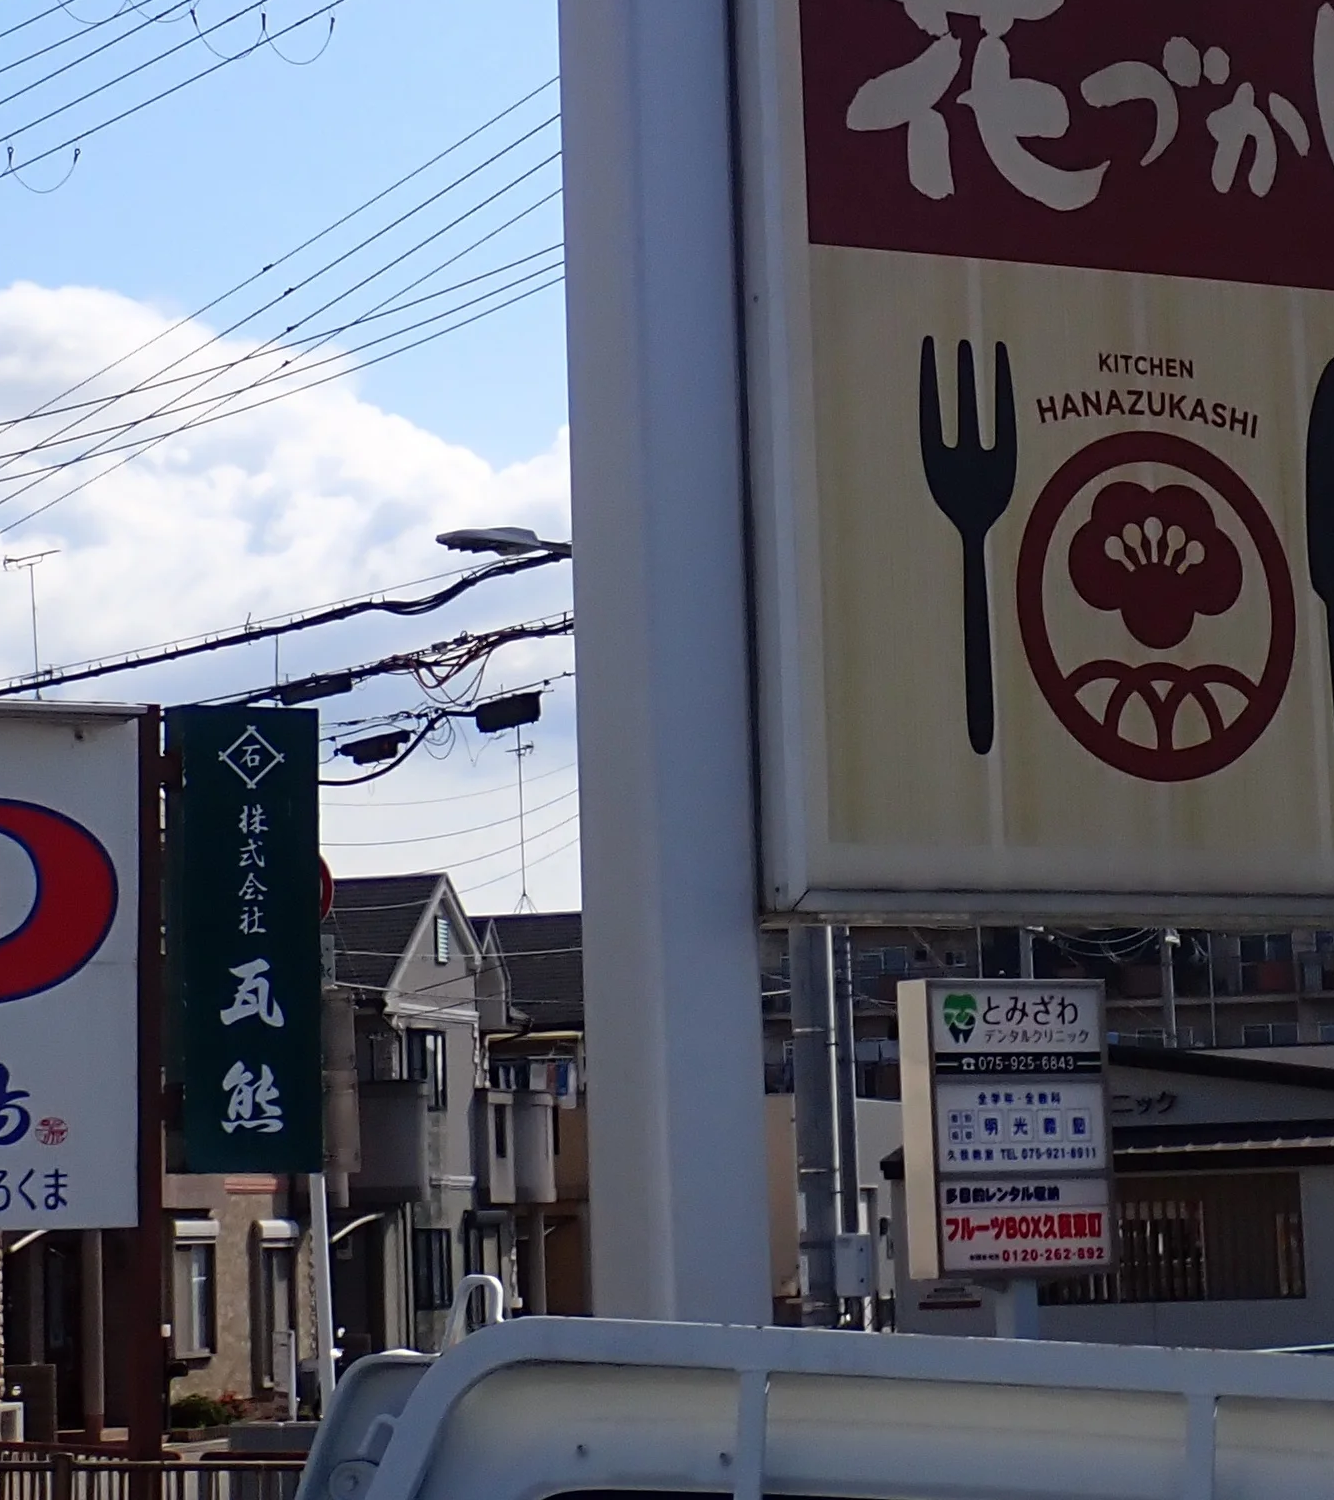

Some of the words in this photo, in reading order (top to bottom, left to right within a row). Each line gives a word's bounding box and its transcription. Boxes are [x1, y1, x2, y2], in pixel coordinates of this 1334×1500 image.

[1098, 352, 1194, 379] KITCHEN
[1036, 390, 1258, 439] HANAZUKASHI
[239, 743, 261, 768] 石
[238, 805, 269, 935] 株式会社
[982, 995, 1079, 1025] とみざわ
[219, 958, 284, 1134] 瓦熊
[984, 1028, 1089, 1044] デンタルクリニック
[978, 1056, 1074, 1070] 075-925-6843
